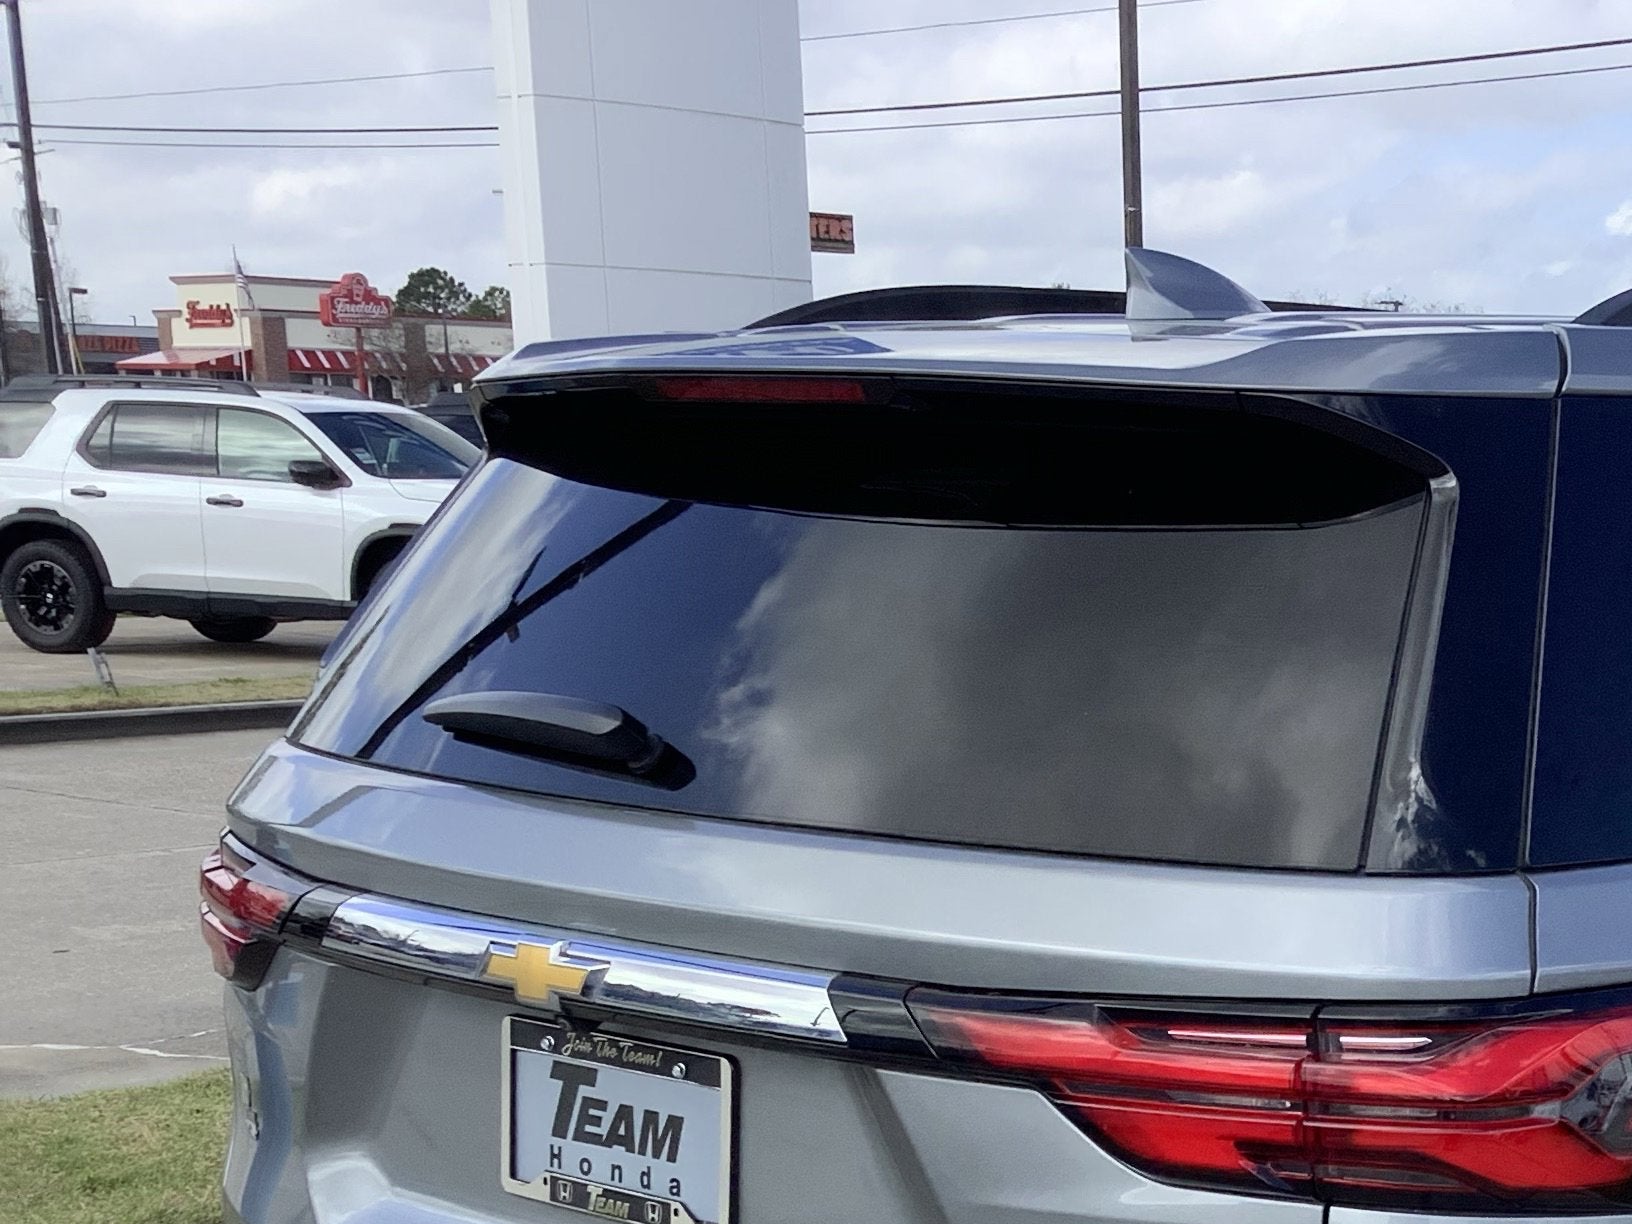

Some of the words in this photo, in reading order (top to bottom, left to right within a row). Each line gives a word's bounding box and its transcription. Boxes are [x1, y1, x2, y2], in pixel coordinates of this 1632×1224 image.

[333, 297, 388, 319] Freddy's
[561, 1032, 592, 1056] Join
[593, 1036, 618, 1058] The
[619, 1042, 663, 1067] Team!
[549, 1060, 685, 1163] TEAM
[549, 1143, 681, 1197] Honda
